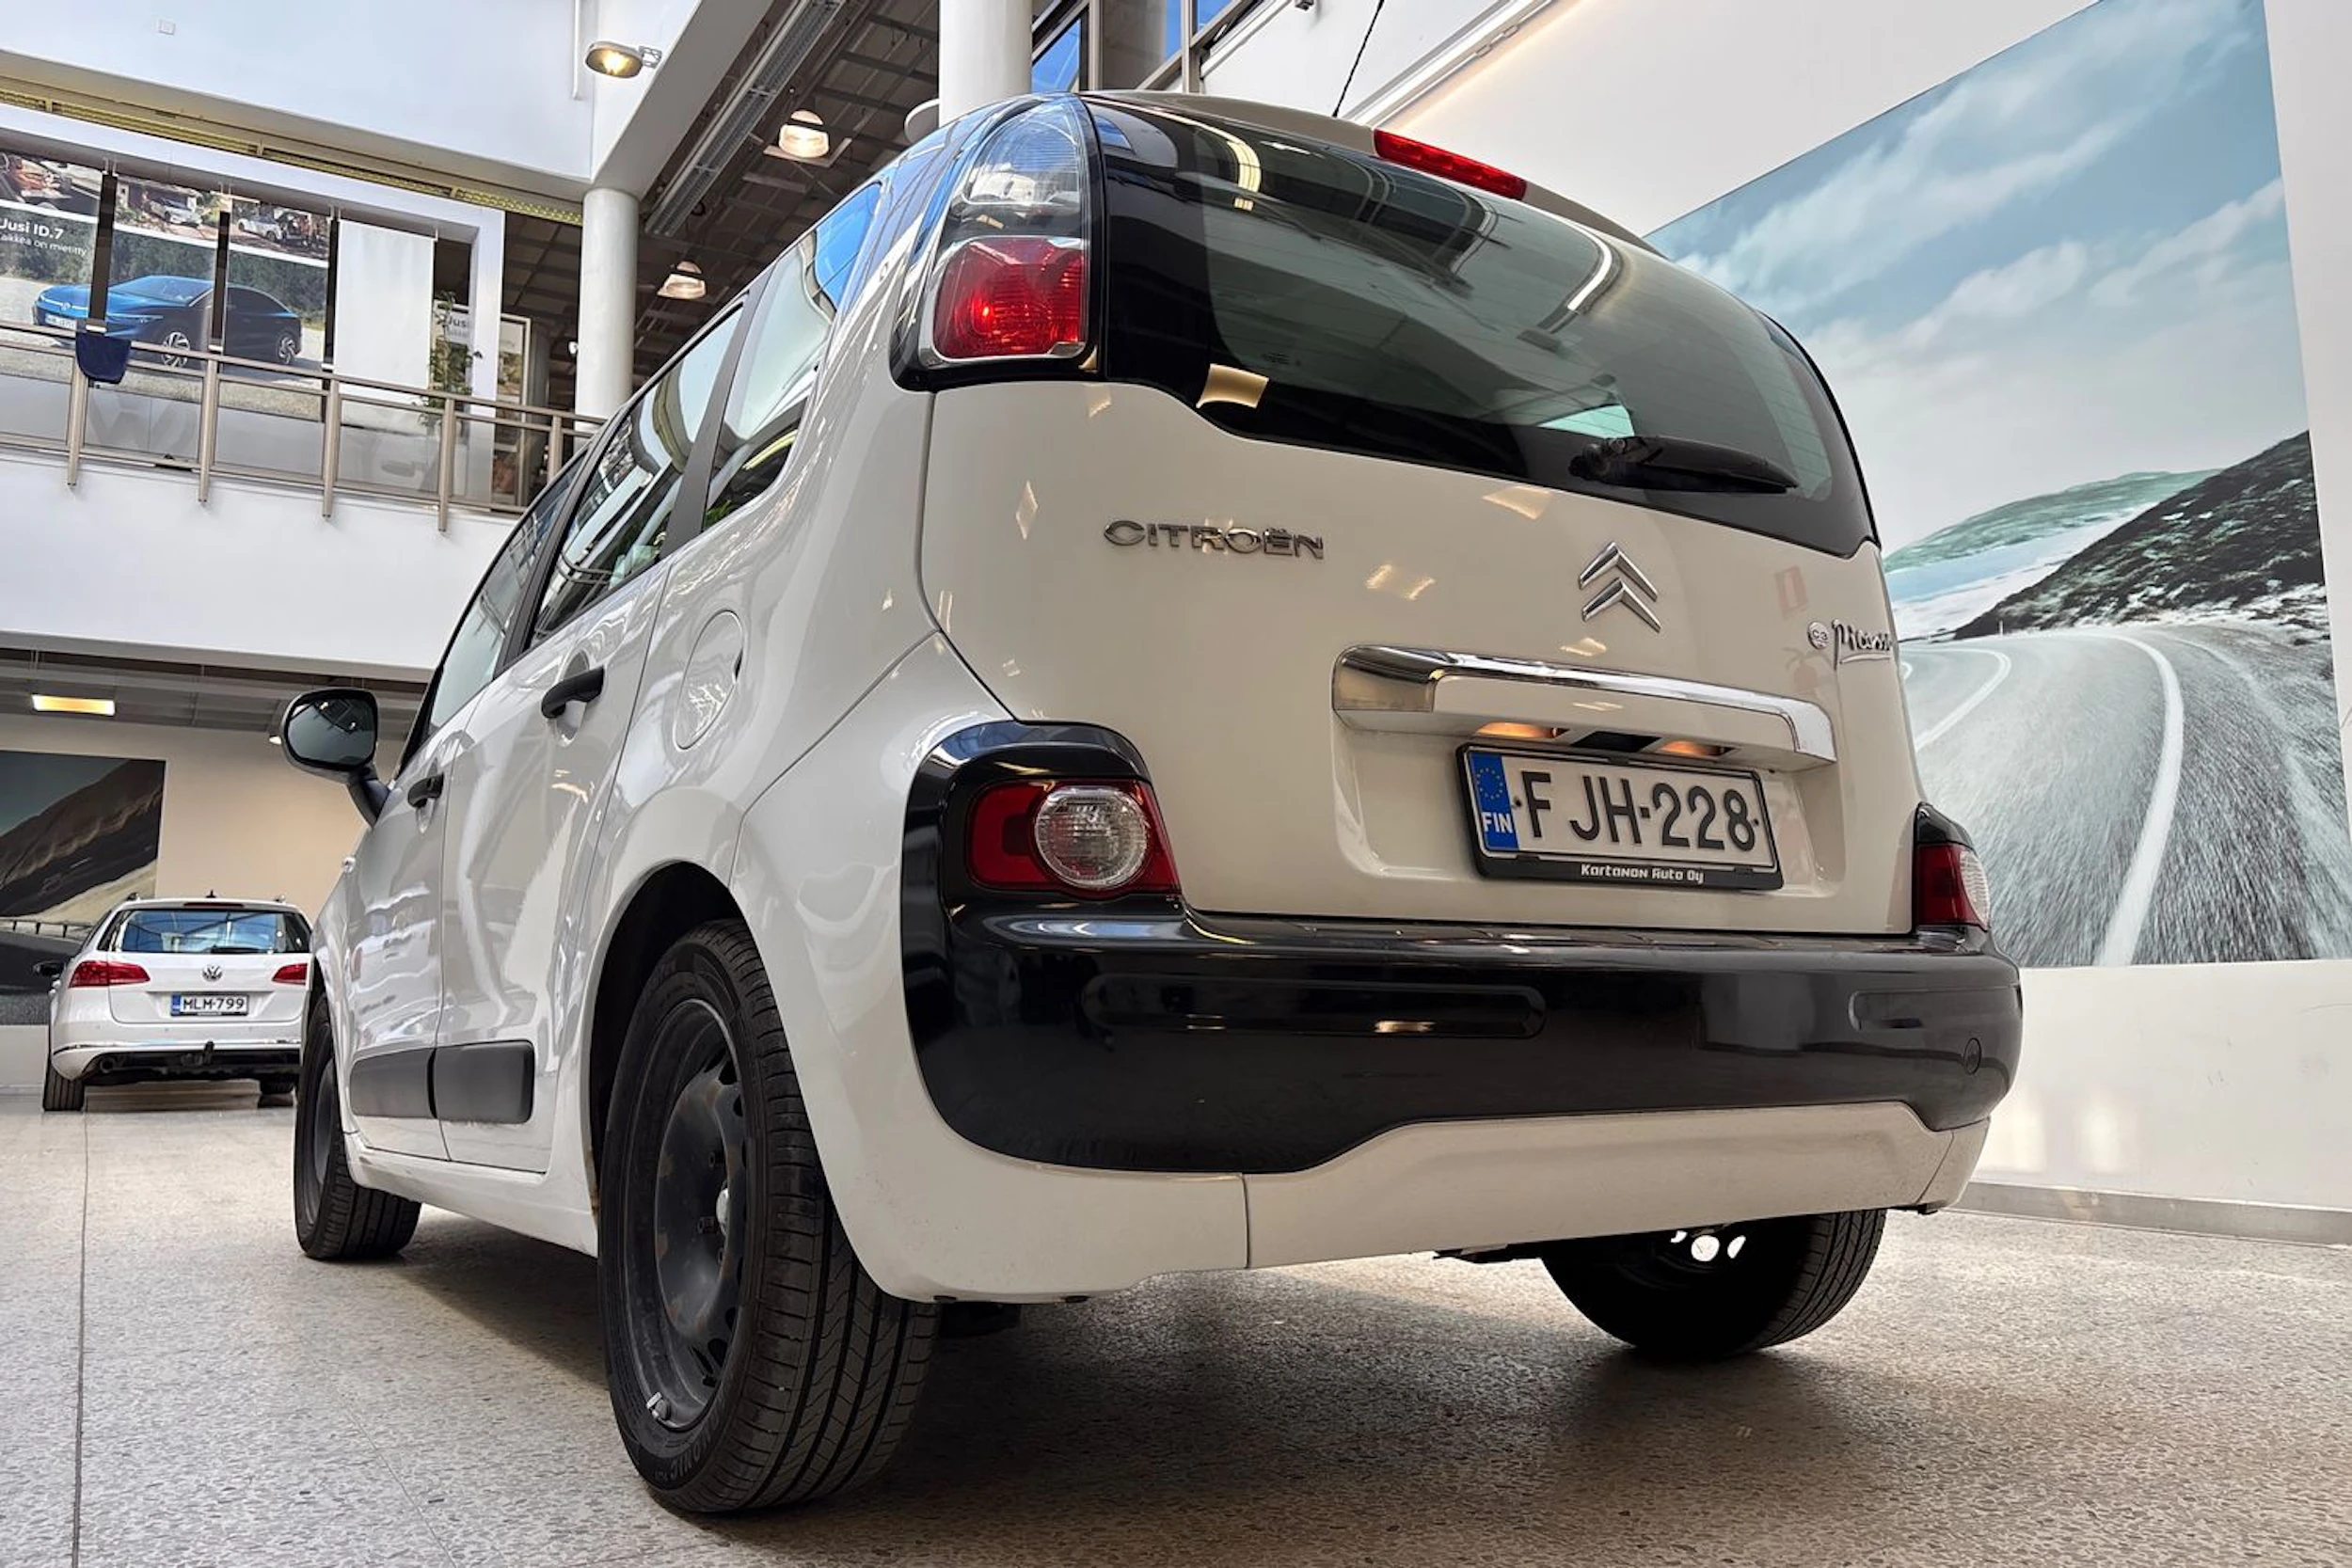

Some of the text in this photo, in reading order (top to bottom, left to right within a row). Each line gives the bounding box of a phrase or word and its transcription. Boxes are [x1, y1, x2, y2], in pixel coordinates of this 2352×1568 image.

[33, 223, 64, 240] ID.7
[34, 239, 48, 249] on
[1104, 519, 1325, 560] CITROËN
[1481, 811, 1514, 834] FIN
[1651, 867, 1684, 881] Auto
[1686, 869, 1705, 884] Oy
[183, 998, 244, 1010] MLM-799
